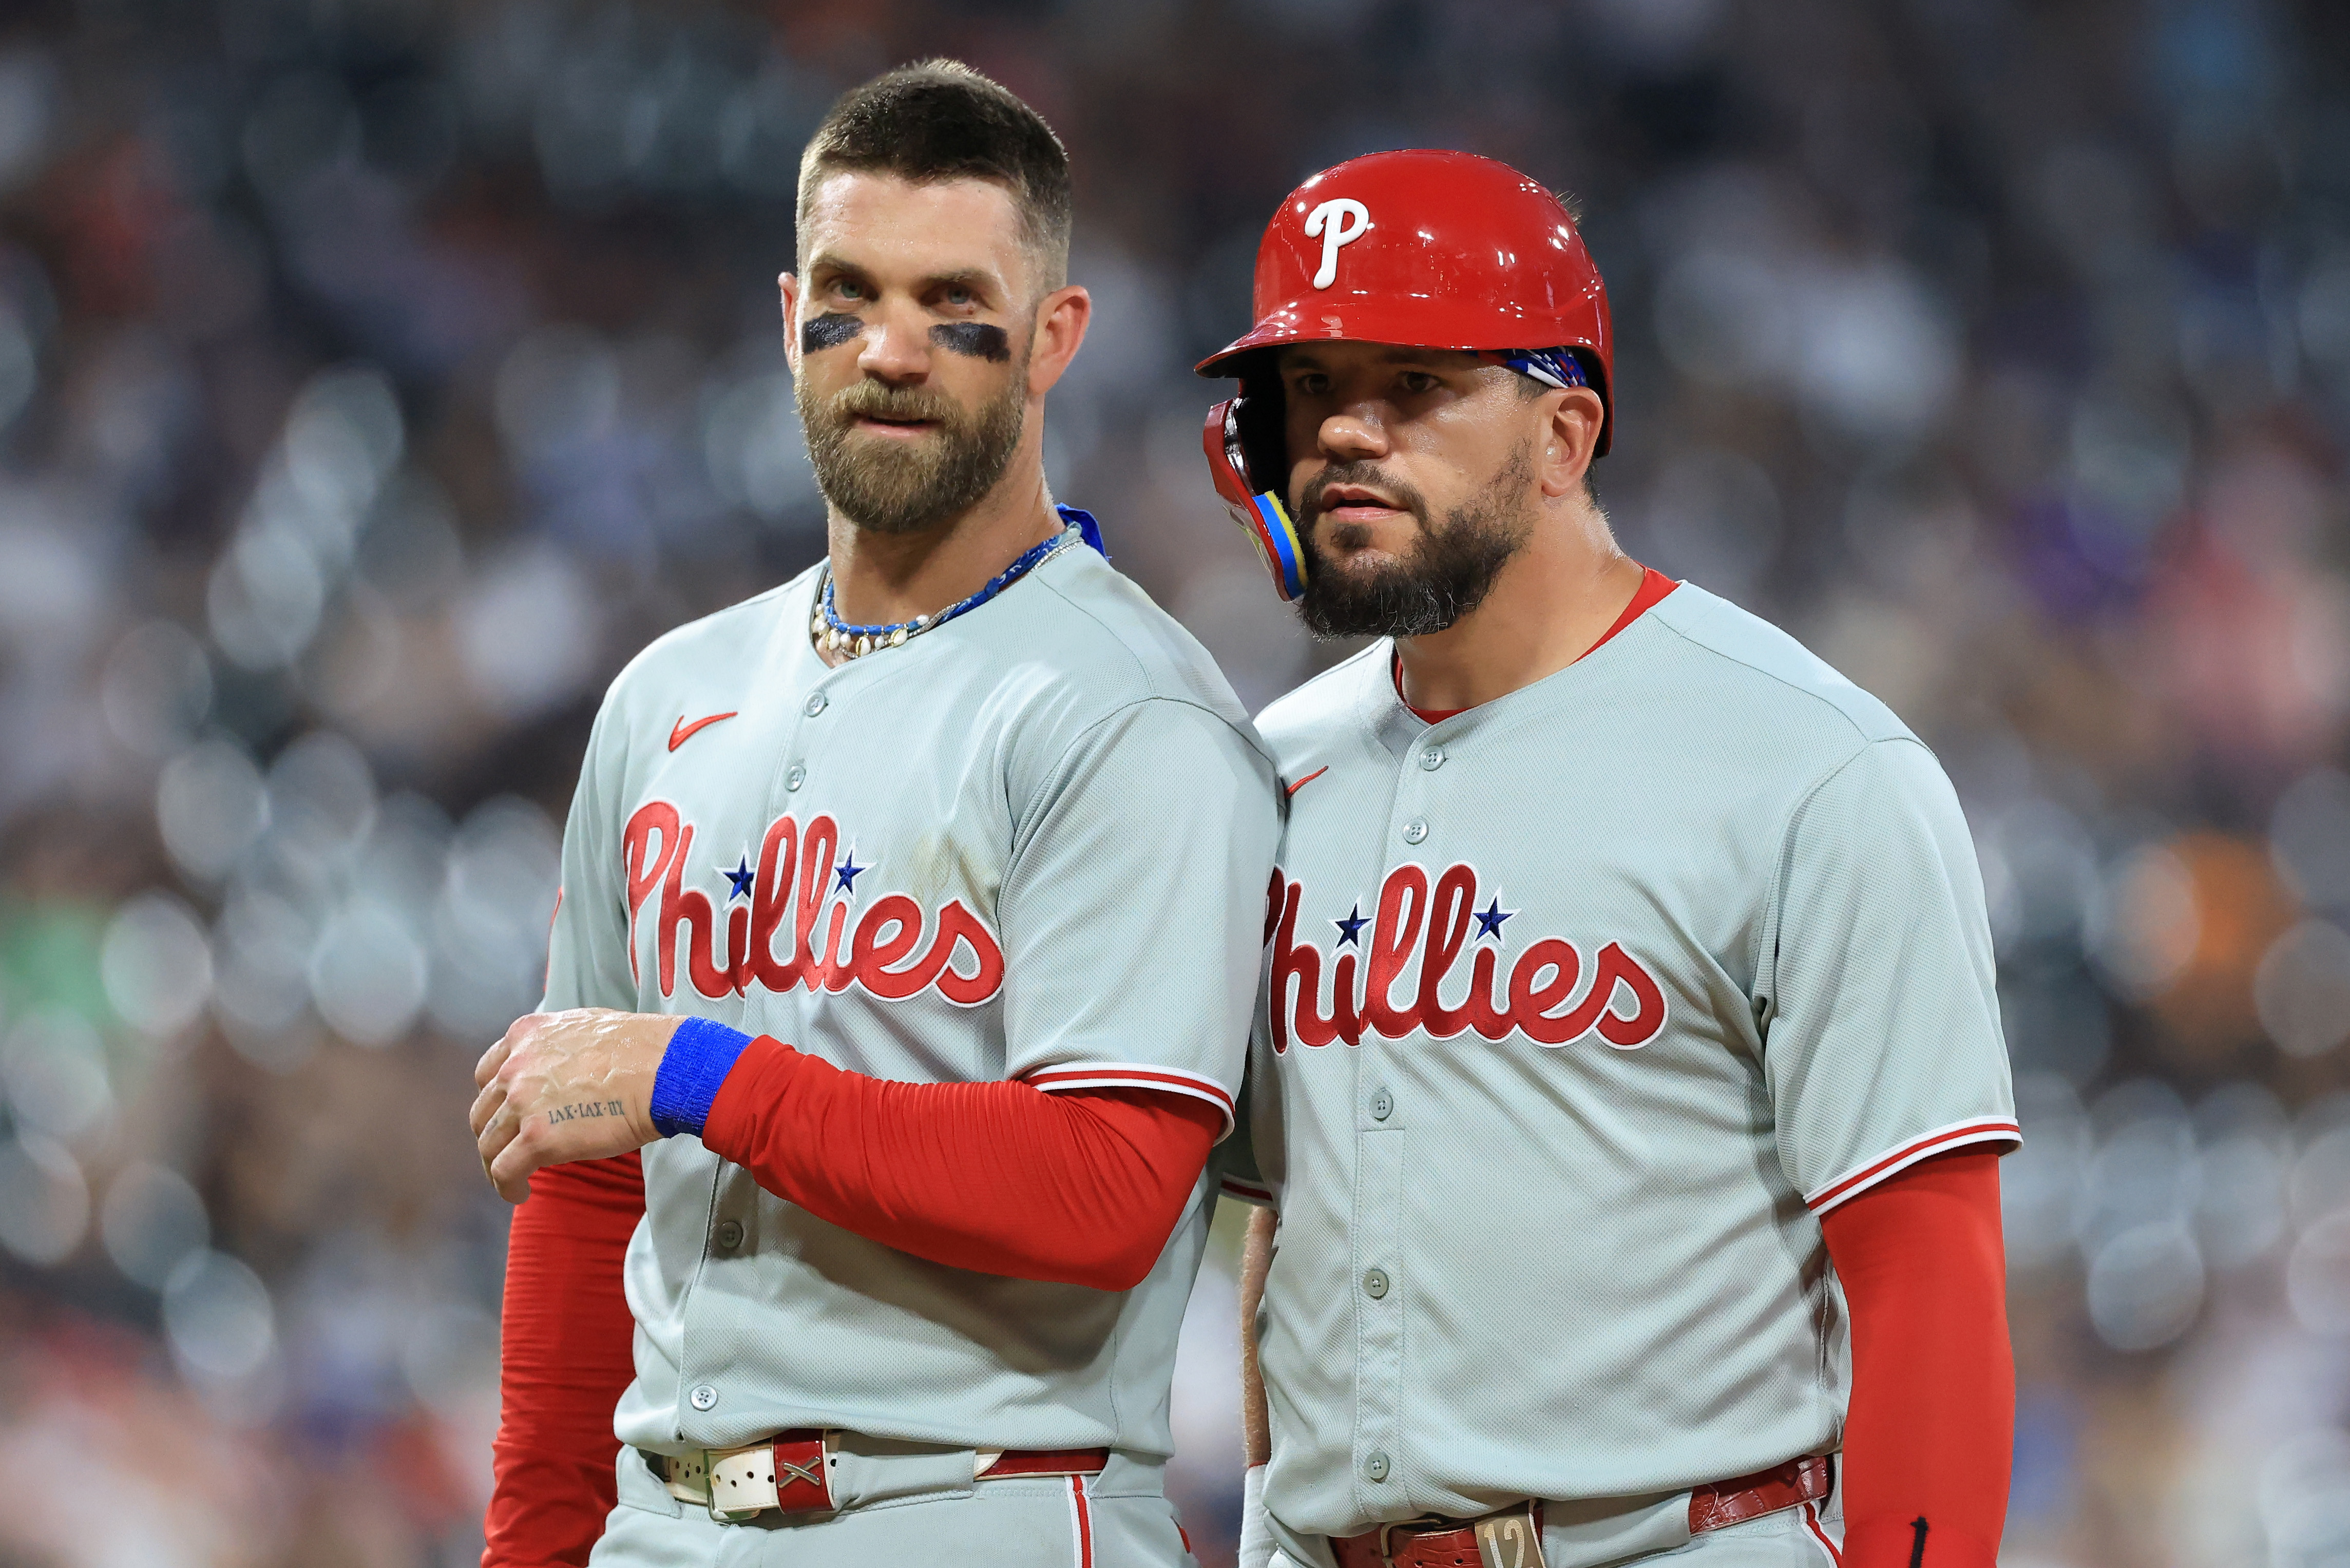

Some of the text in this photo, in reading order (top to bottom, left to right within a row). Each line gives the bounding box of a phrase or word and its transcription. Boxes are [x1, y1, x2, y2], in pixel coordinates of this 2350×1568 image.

[1304, 198, 1370, 290] P
[622, 796, 1005, 1008] Phillies
[1483, 1519, 1534, 1568] 12
